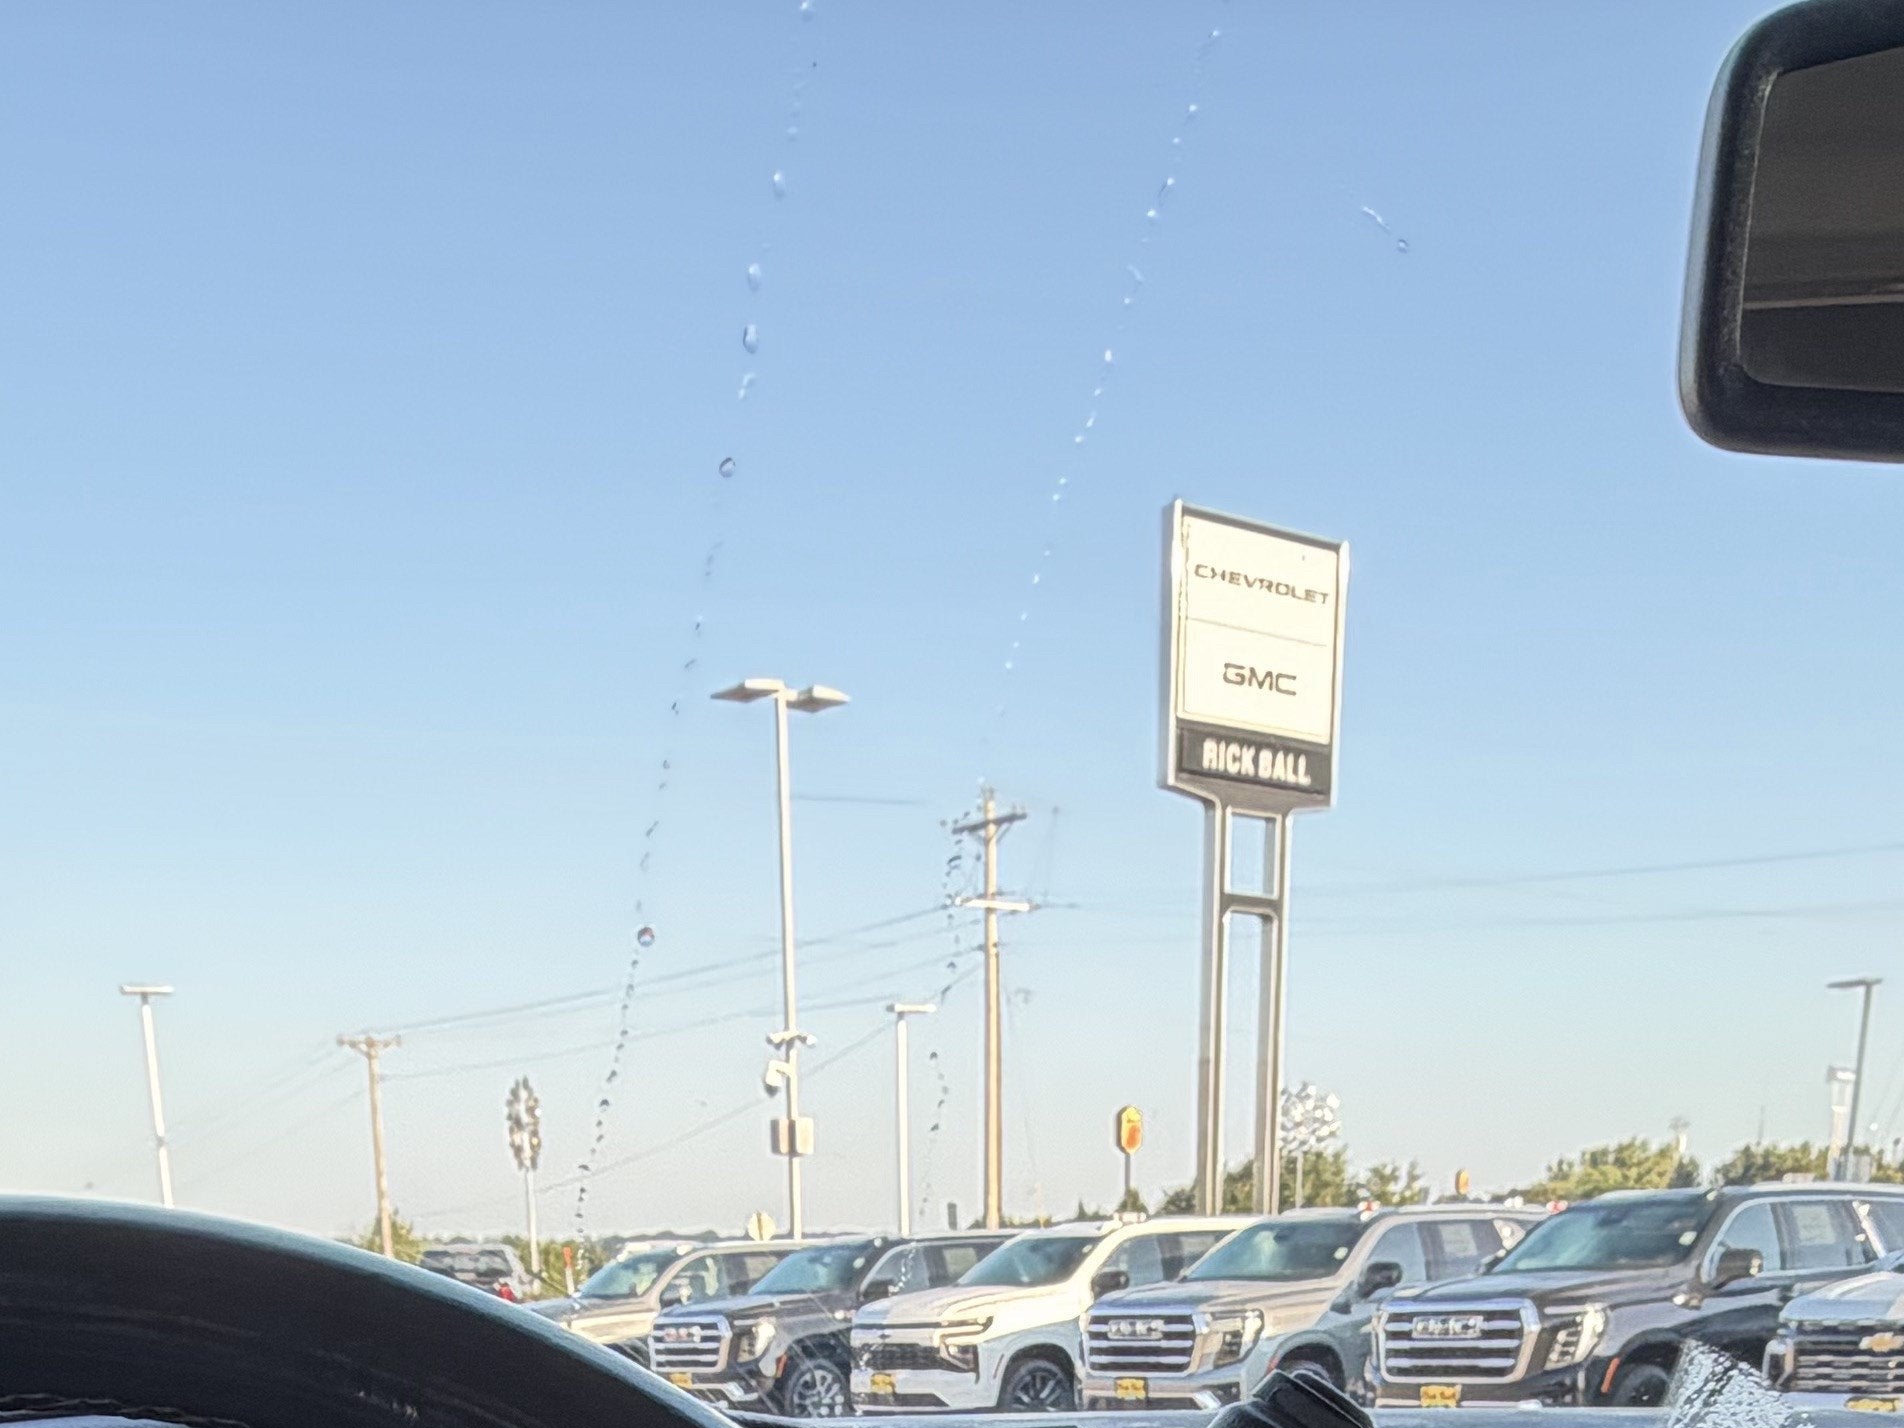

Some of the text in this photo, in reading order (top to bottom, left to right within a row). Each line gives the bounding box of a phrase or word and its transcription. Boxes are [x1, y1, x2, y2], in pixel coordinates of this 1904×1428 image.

[1194, 563, 1329, 605] CHEVROLET
[1223, 662, 1297, 696] GMC
[1201, 736, 1312, 786] RICK BALL
